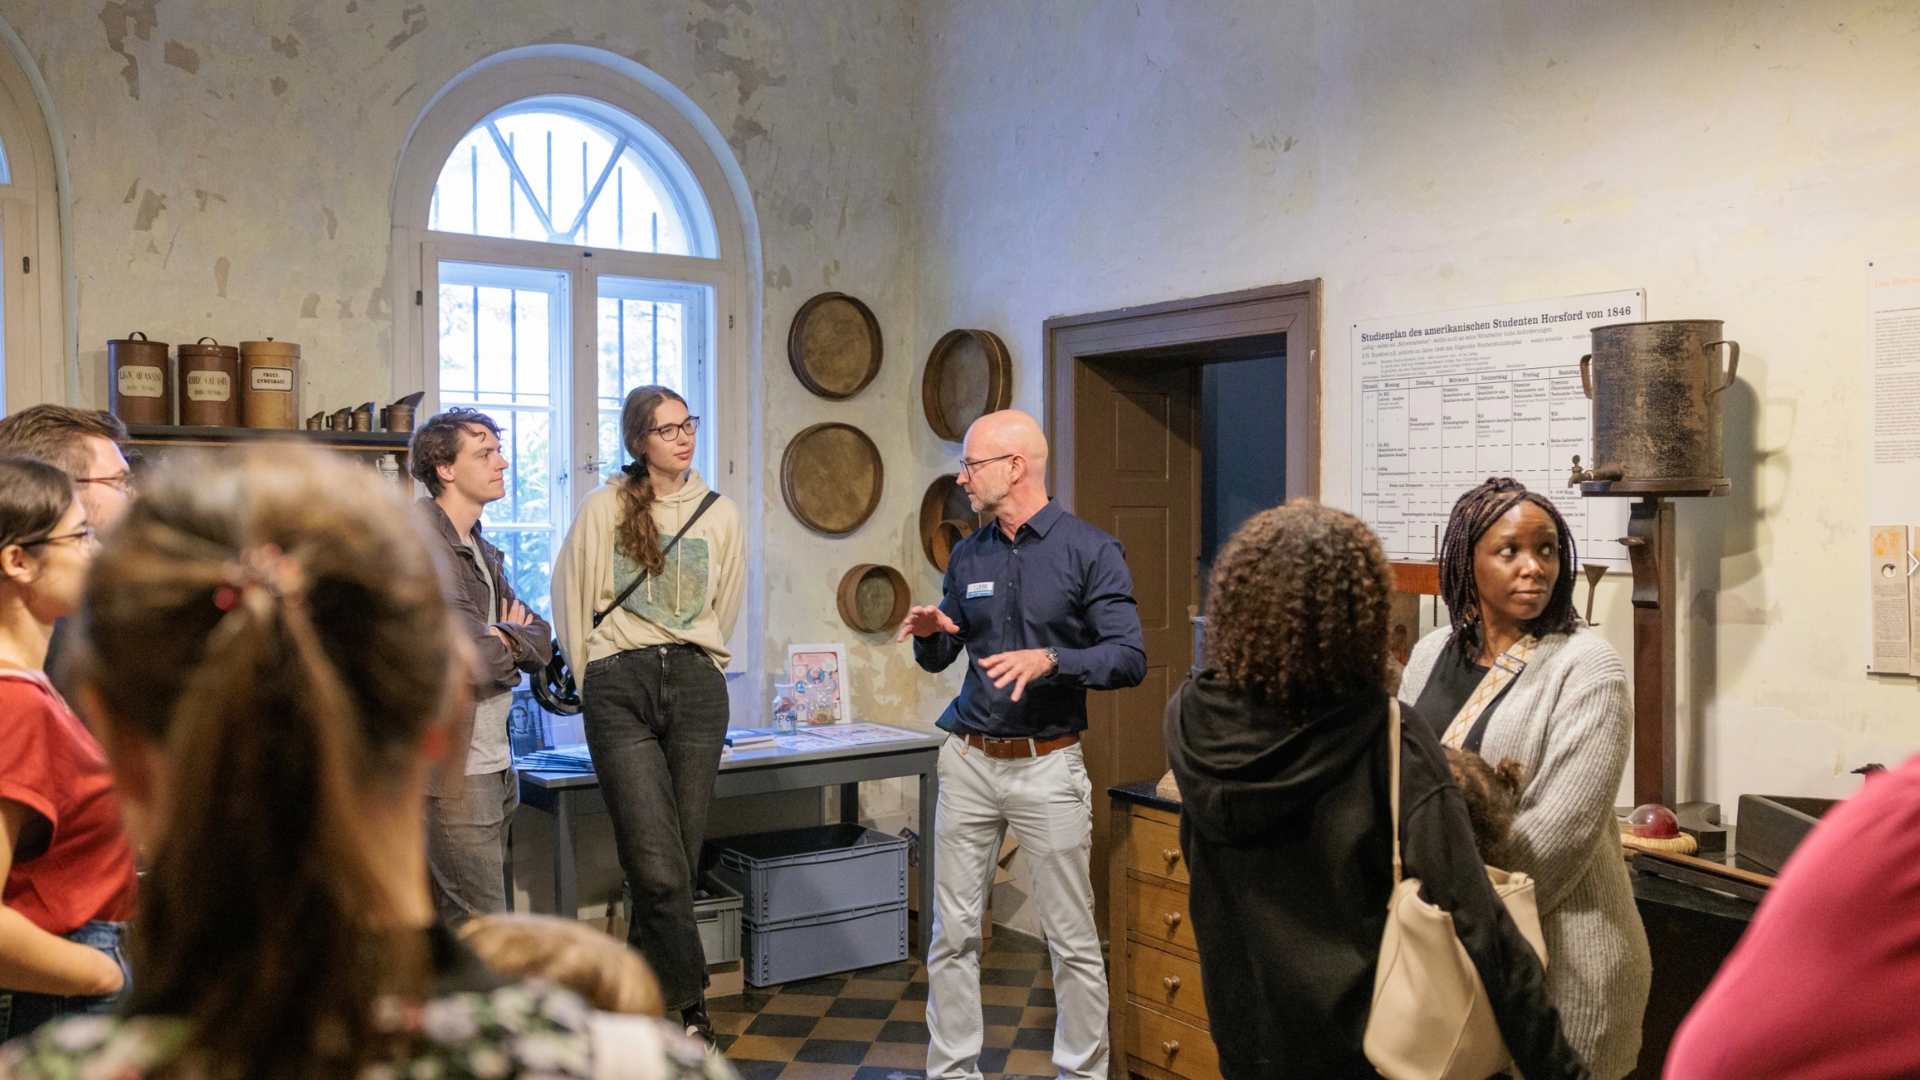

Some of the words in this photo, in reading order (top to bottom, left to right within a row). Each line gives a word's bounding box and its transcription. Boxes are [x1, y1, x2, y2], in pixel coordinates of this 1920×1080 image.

[1361, 329, 1407, 343] Studienplan
[1409, 328, 1422, 337] des
[1425, 321, 1490, 335] amerikanischen
[1493, 316, 1539, 329] Studenten
[1541, 310, 1583, 324] Horsford
[1586, 309, 1603, 319] von
[1606, 306, 1632, 317] 1846
